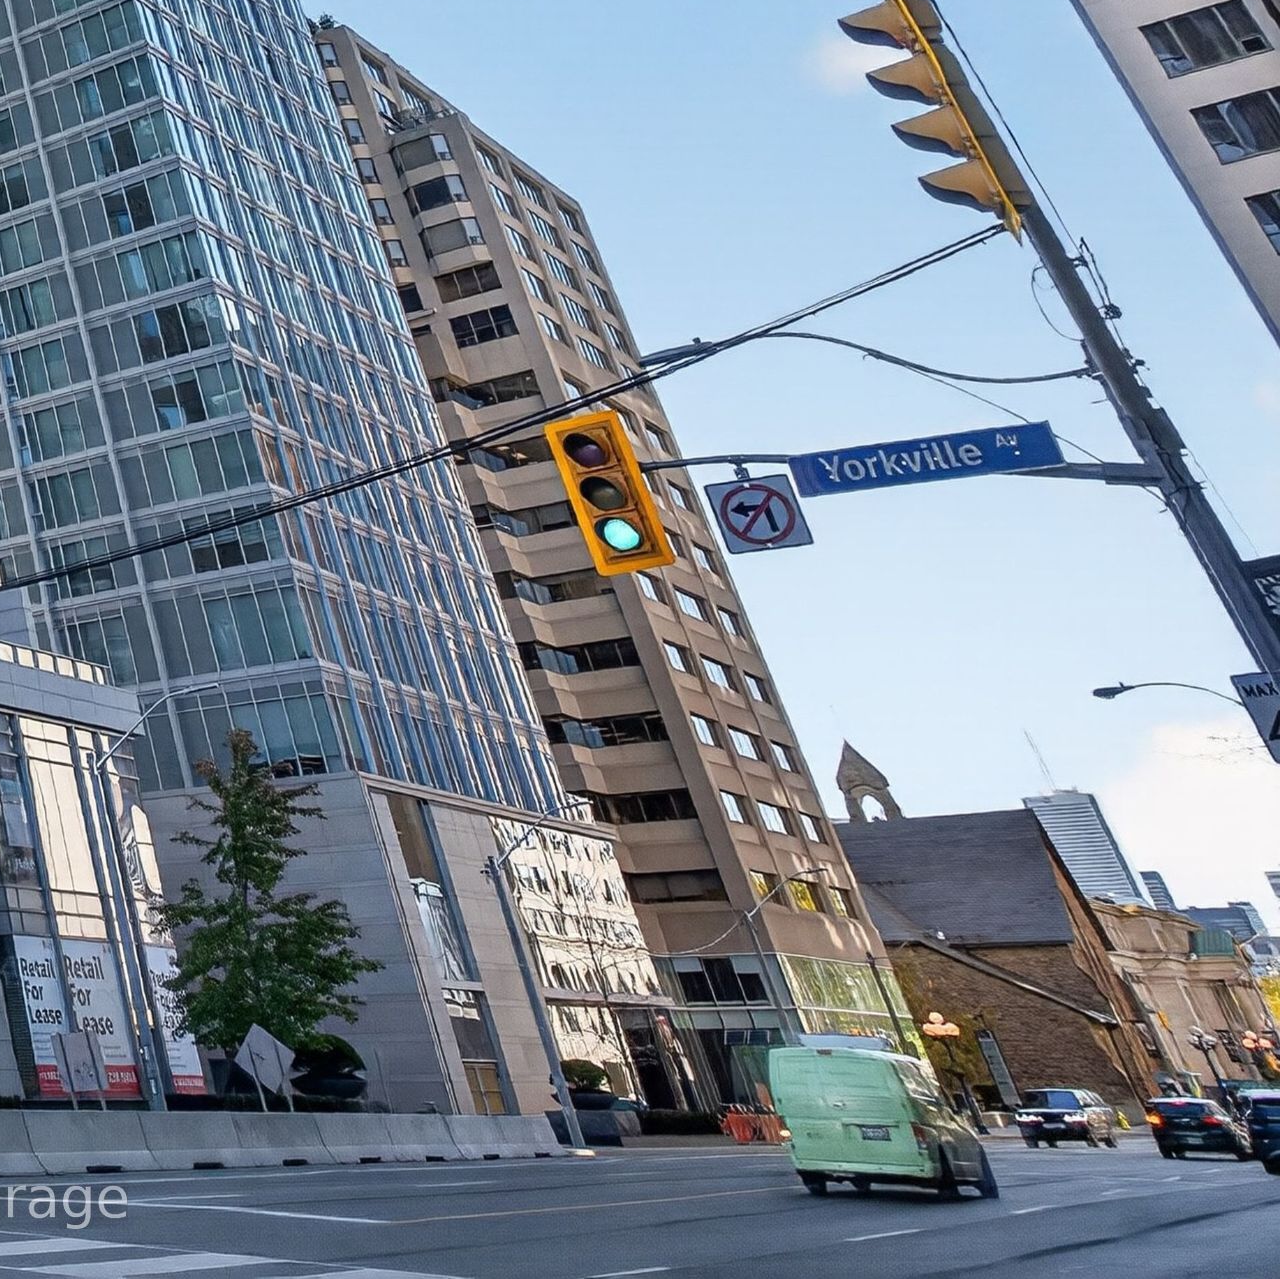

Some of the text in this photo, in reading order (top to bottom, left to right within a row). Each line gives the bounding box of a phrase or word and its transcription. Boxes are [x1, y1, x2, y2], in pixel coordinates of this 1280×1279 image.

[818, 432, 1018, 483] Yorkville Av
[19, 957, 57, 980] Retail
[63, 954, 105, 981] Retail
[25, 982, 44, 1001] For
[70, 984, 92, 1007] For
[28, 1005, 63, 1025] Lease
